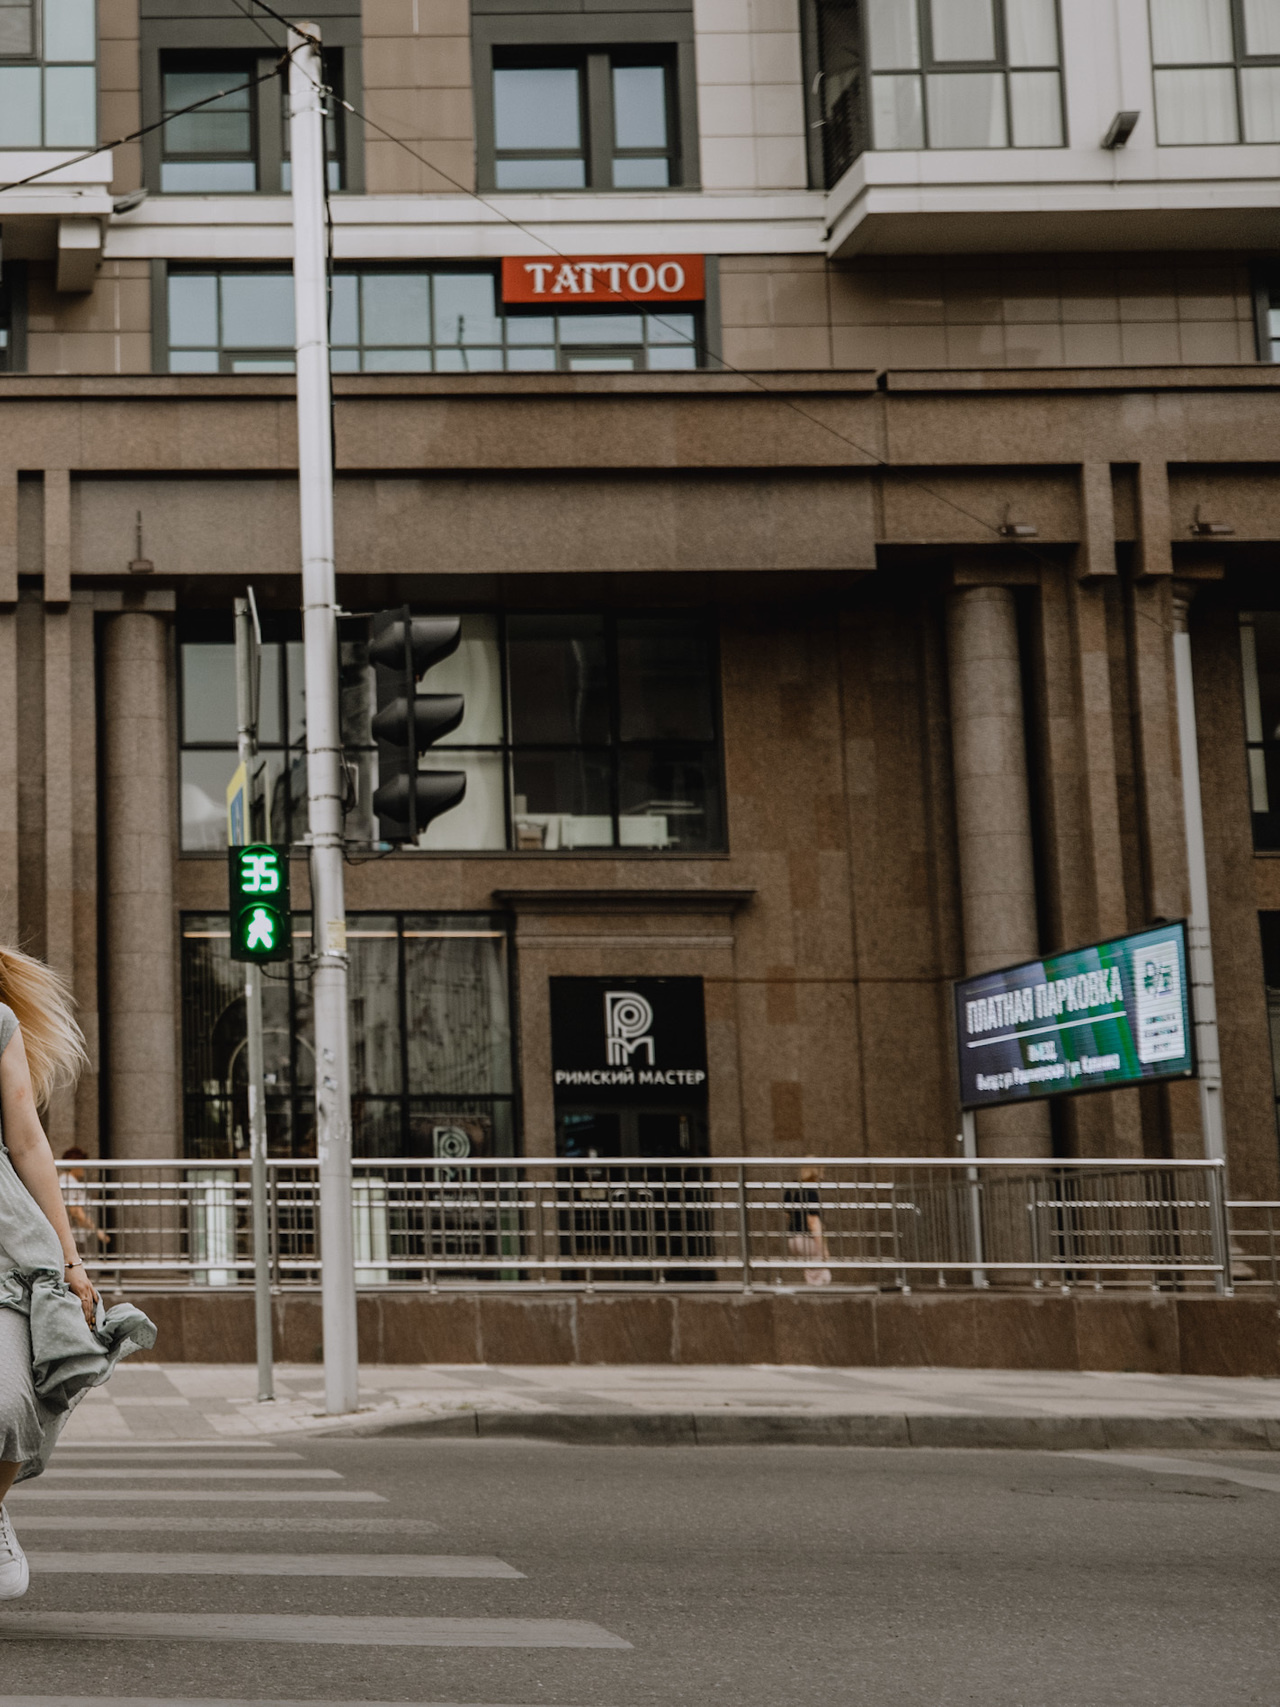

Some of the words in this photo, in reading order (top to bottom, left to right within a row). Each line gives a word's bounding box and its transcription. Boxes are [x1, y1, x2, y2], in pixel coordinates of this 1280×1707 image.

[524, 262, 685, 294] TATTOO
[241, 855, 279, 892] 35
[966, 987, 1035, 1034] ПЛАТНАЯ
[1034, 966, 1123, 1019] ПАРКОВКА
[555, 1067, 635, 1085] РИМСКИЙ
[639, 1069, 706, 1085] МАСТЕР
